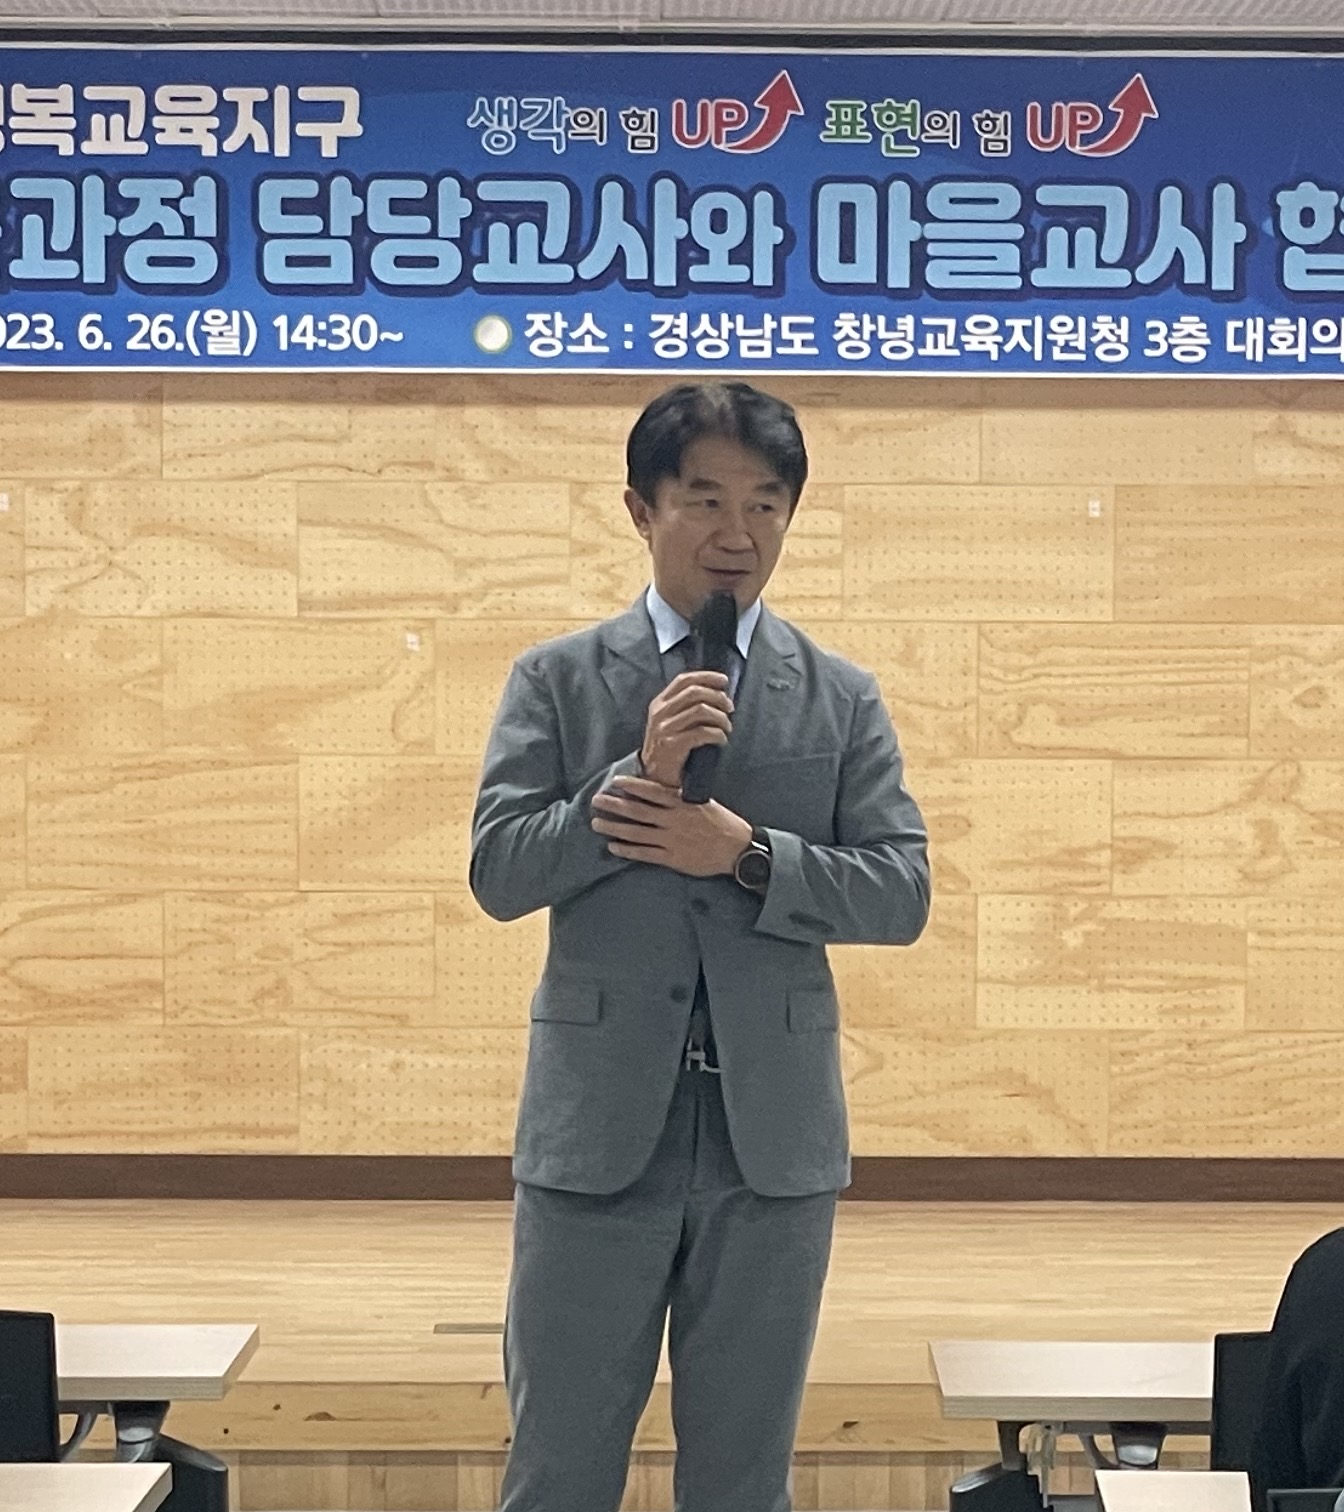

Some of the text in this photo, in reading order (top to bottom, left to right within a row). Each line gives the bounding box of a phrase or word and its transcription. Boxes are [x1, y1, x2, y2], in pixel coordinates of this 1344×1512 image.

[466, 95, 1103, 158] 생각의 힘 UP 표현의 힘 UP
[257, 174, 785, 288] 담당교사와
[816, 179, 1248, 291] 마을교사
[77, 312, 112, 352] 6.
[126, 308, 258, 356] 26.(월)
[272, 313, 405, 353] 14:30~
[524, 313, 609, 357] 장소
[648, 313, 819, 358] 경상남도
[832, 313, 1130, 361] 창녕교육지원청
[1144, 315, 1212, 362] 3층
